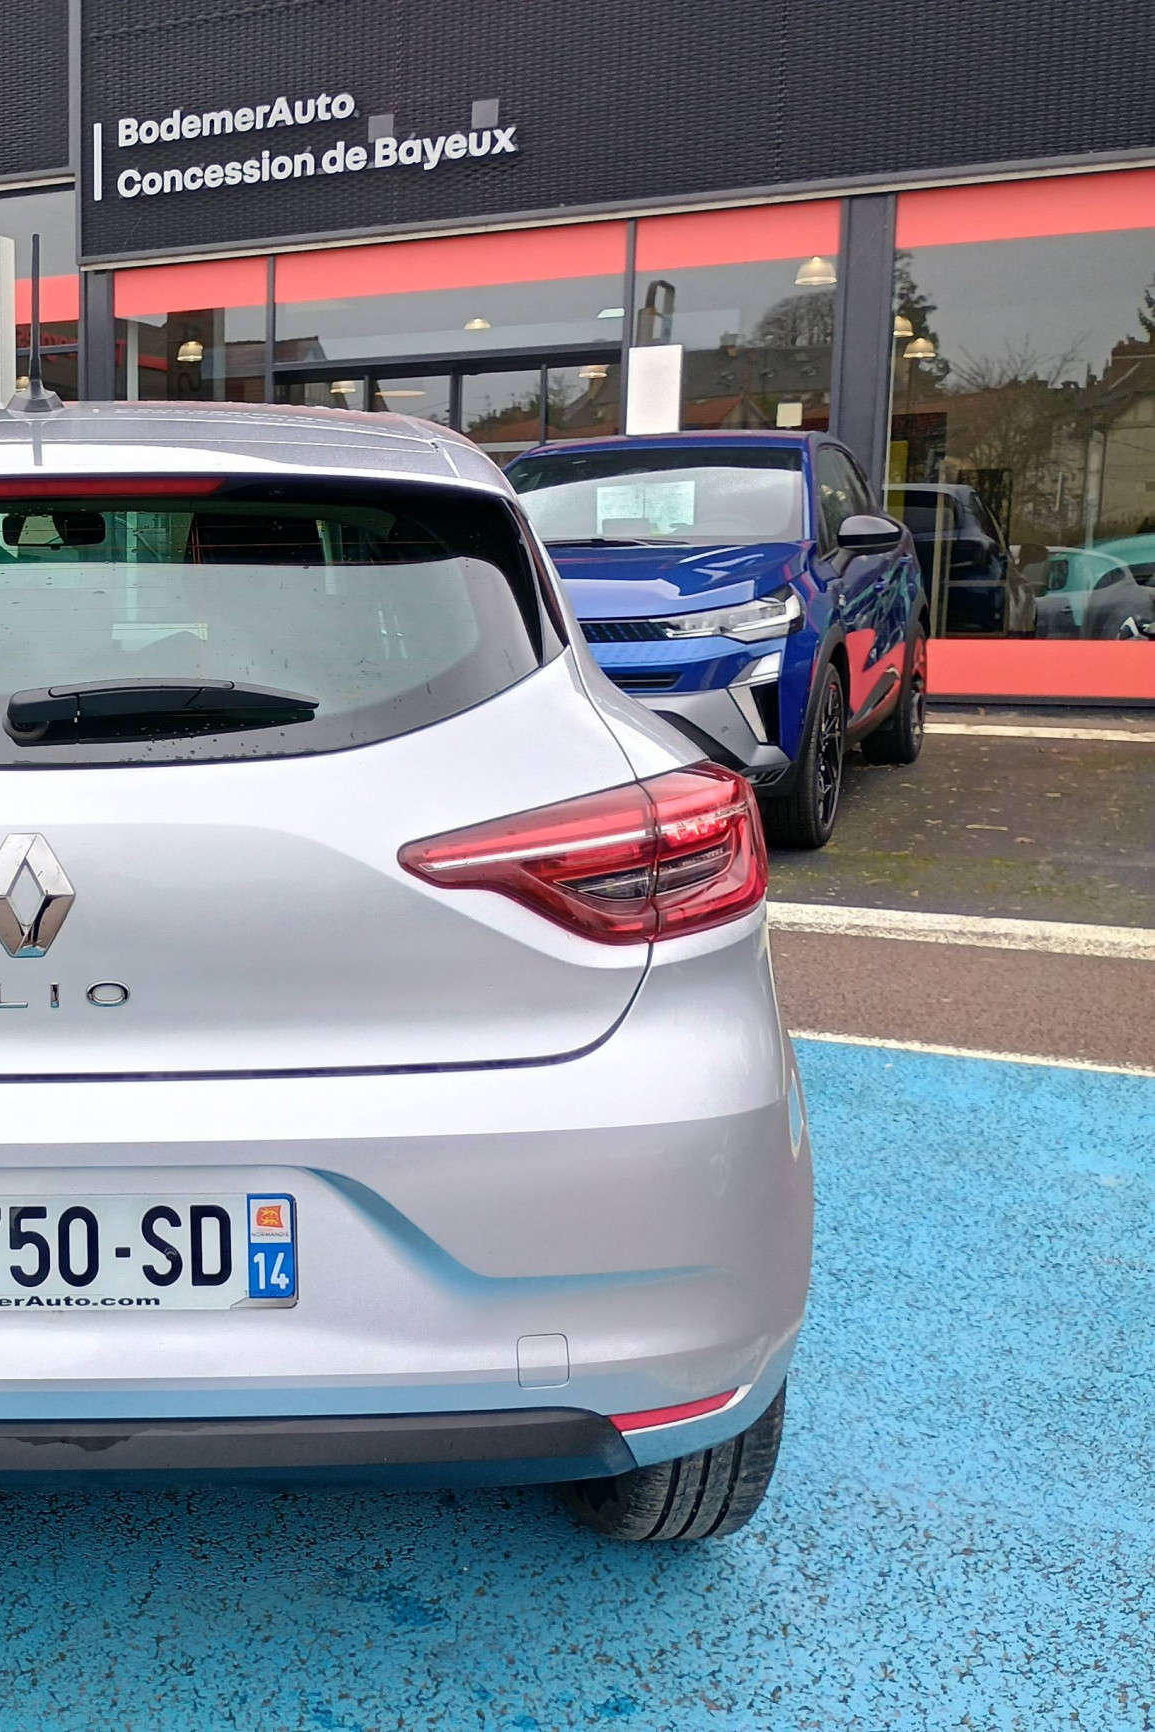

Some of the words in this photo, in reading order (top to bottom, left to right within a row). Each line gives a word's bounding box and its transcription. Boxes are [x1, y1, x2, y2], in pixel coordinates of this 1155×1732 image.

[117, 92, 356, 148] BodemerAuto
[116, 150, 313, 199] Concession
[321, 141, 367, 174] de
[373, 125, 517, 171] Bayeux
[252, 1251, 290, 1290] 14
